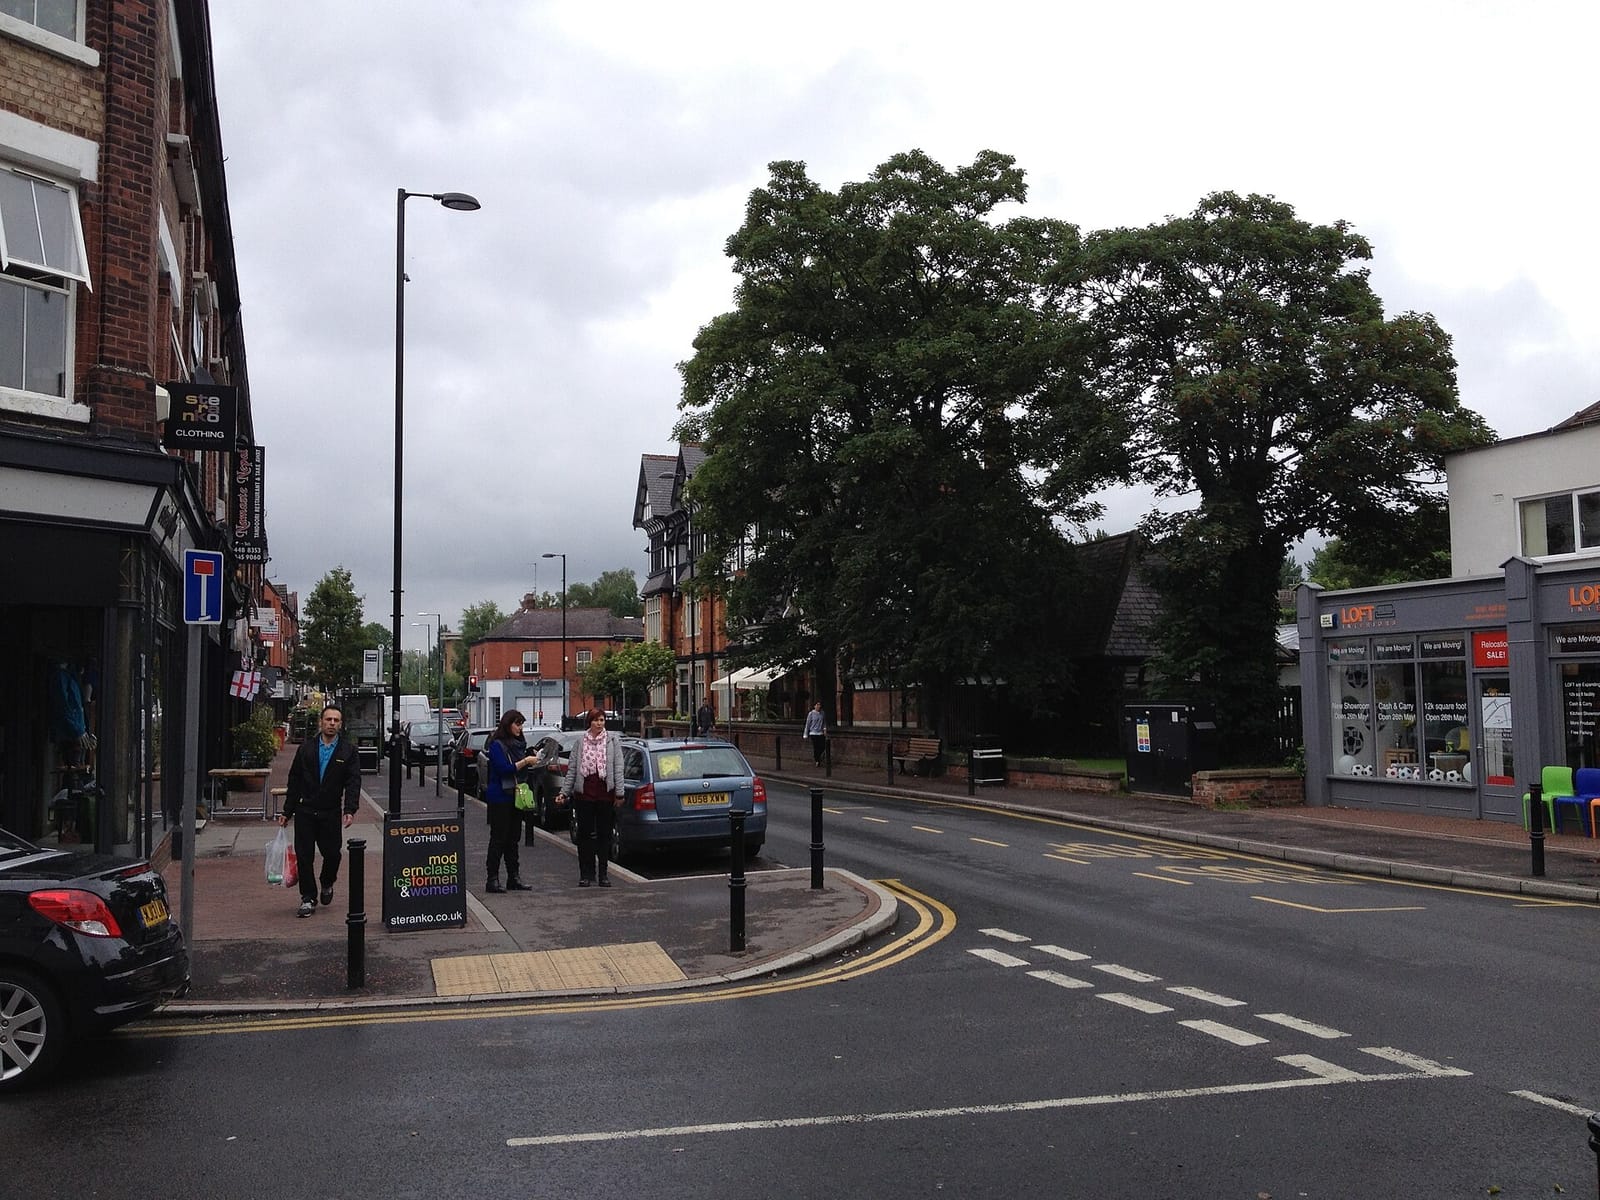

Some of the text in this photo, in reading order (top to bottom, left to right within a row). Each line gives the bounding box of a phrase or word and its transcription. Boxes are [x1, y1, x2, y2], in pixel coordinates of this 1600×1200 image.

[175, 429, 225, 439] CLOTHING
[236, 447, 253, 484] Nepal
[253, 481, 261, 513] RESTAURANT
[235, 486, 251, 538] Namaste
[253, 513, 261, 539] TANDOORI
[1341, 604, 1376, 624] LOFT
[1555, 635, 1567, 643] We
[1578, 634, 1600, 645] Moving
[1349, 645, 1366, 655] Moving!
[1376, 645, 1385, 653] We
[1393, 643, 1412, 653] Moving!
[1424, 642, 1433, 650] We
[1442, 640, 1462, 650] Moving!
[1486, 651, 1506, 659] SALE!
[1343, 702, 1370, 710] Showroom
[1378, 702, 1392, 710] Cash
[1398, 702, 1414, 712] Carry
[1424, 702, 1468, 711] 12k square foot
[1334, 713, 1347, 722] Open
[1378, 713, 1391, 722] Open
[1403, 713, 1416, 723] May!
[1425, 713, 1467, 723] Open 26th May!
[687, 794, 708, 804] AU58
[390, 823, 460, 836] steranko
[402, 834, 447, 844] CLOTHING
[428, 851, 458, 865] mod
[390, 910, 463, 926] steranko.co.uk
